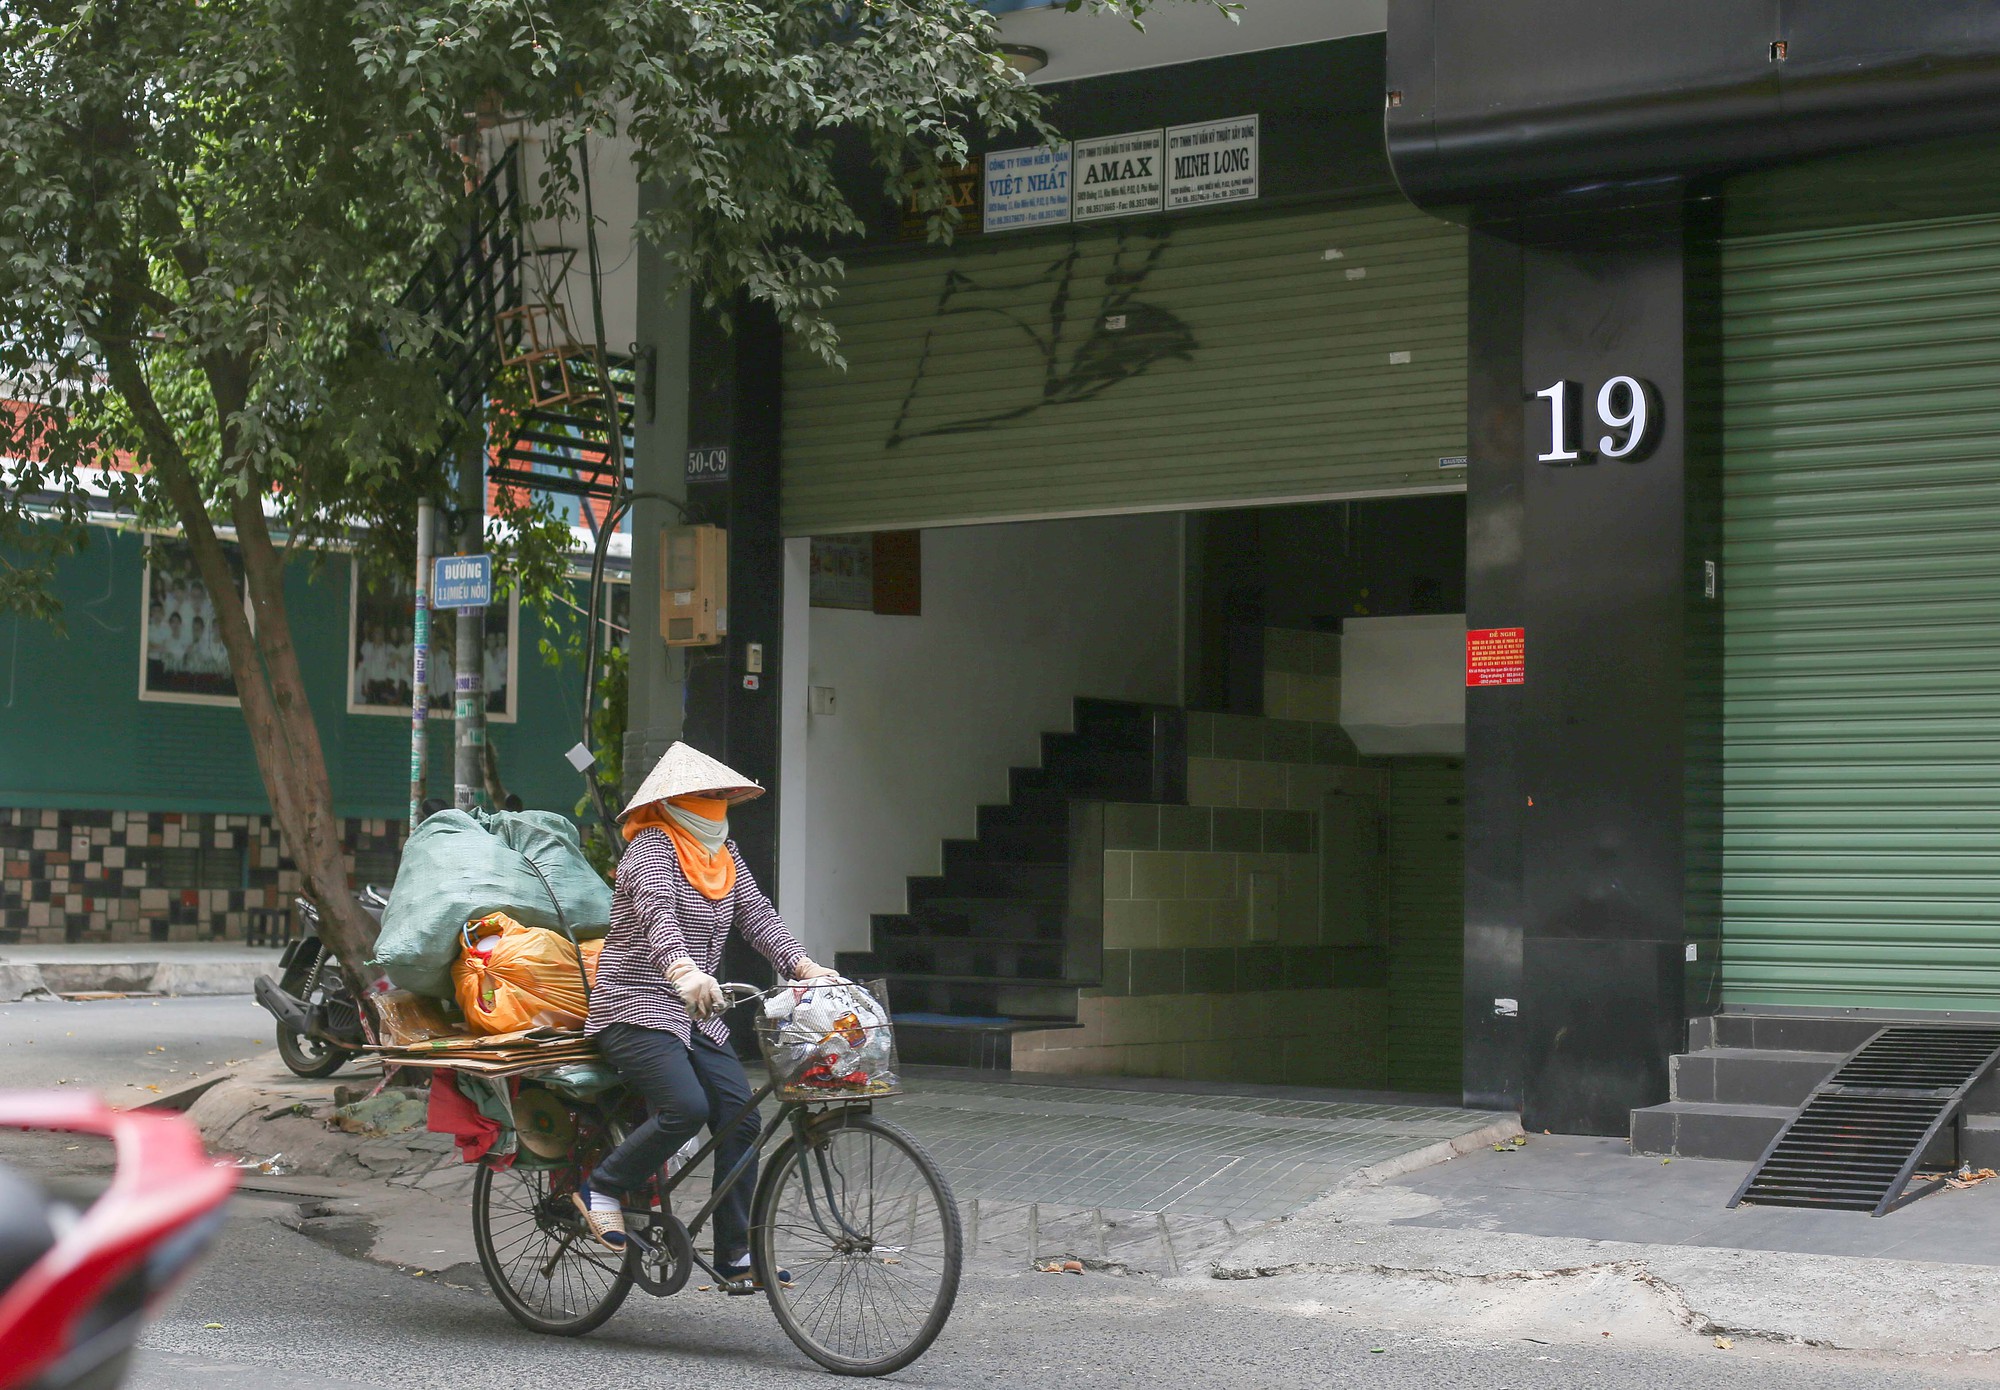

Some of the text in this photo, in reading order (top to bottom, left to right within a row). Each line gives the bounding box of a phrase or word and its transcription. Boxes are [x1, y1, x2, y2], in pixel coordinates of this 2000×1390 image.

[1084, 156, 1152, 184] AMAX
[1175, 147, 1249, 180] MINH LONG
[990, 164, 1067, 199] VIỆT NHẤT
[1536, 375, 1647, 462] 19
[445, 559, 482, 580] ĐƯỜNG
[438, 581, 468, 601] 11(MIẾU
